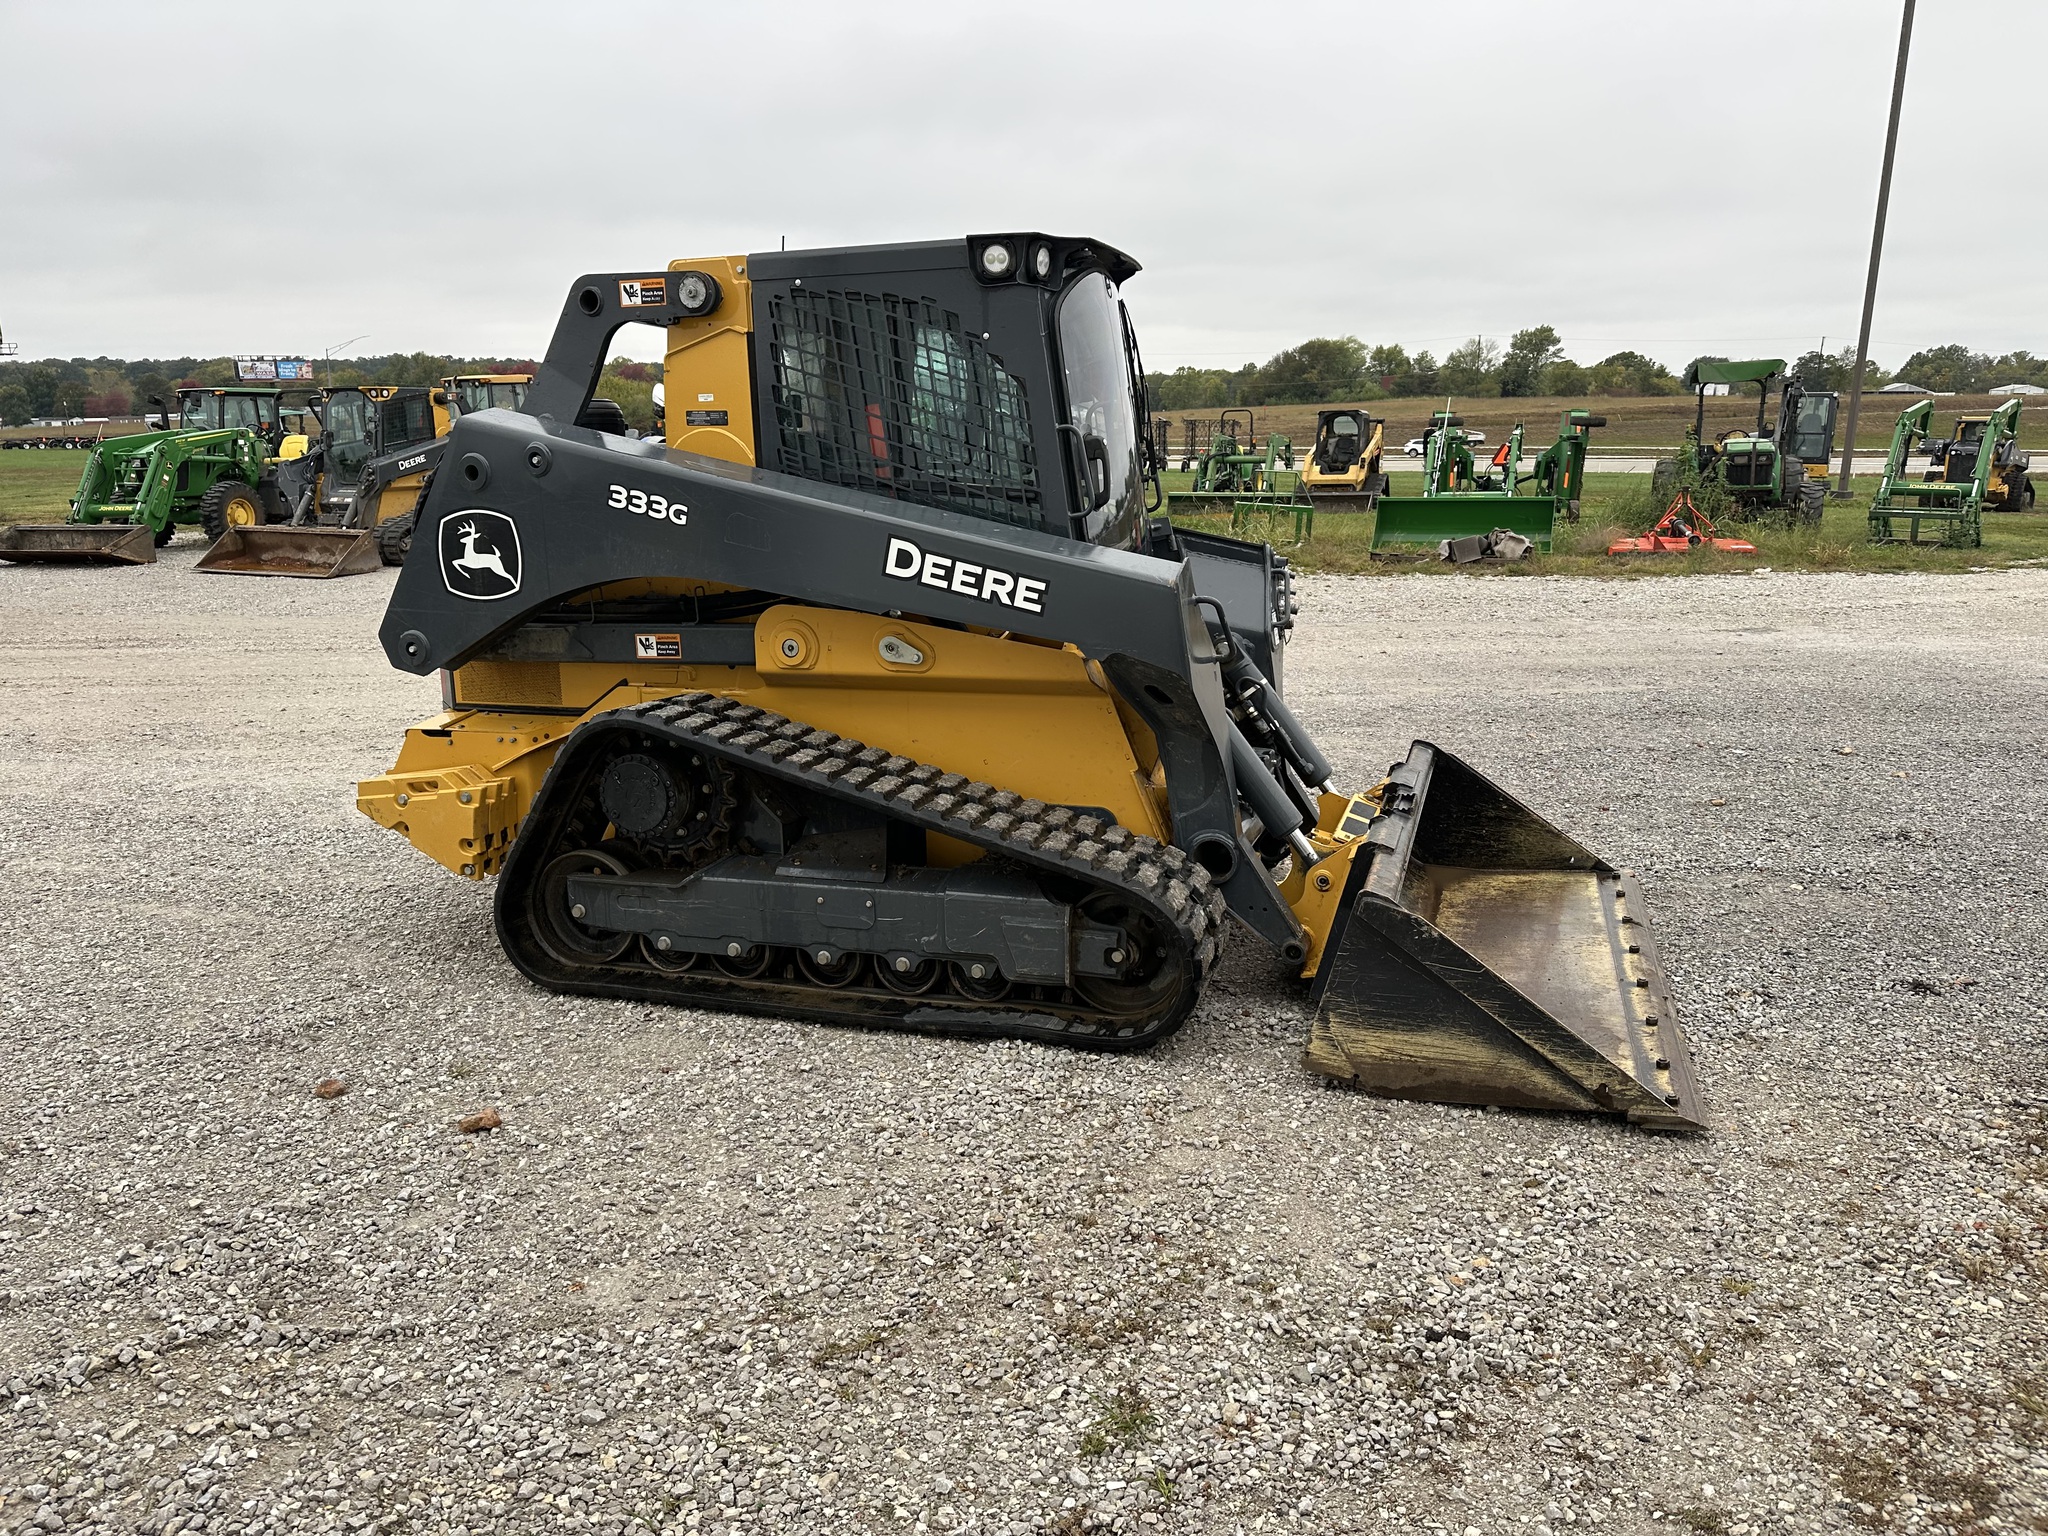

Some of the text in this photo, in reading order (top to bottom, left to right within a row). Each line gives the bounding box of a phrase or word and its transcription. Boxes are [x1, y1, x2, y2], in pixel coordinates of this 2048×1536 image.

[398, 454, 427, 471] DEERE
[608, 484, 688, 525] 333G
[885, 537, 1047, 613] DEERE
